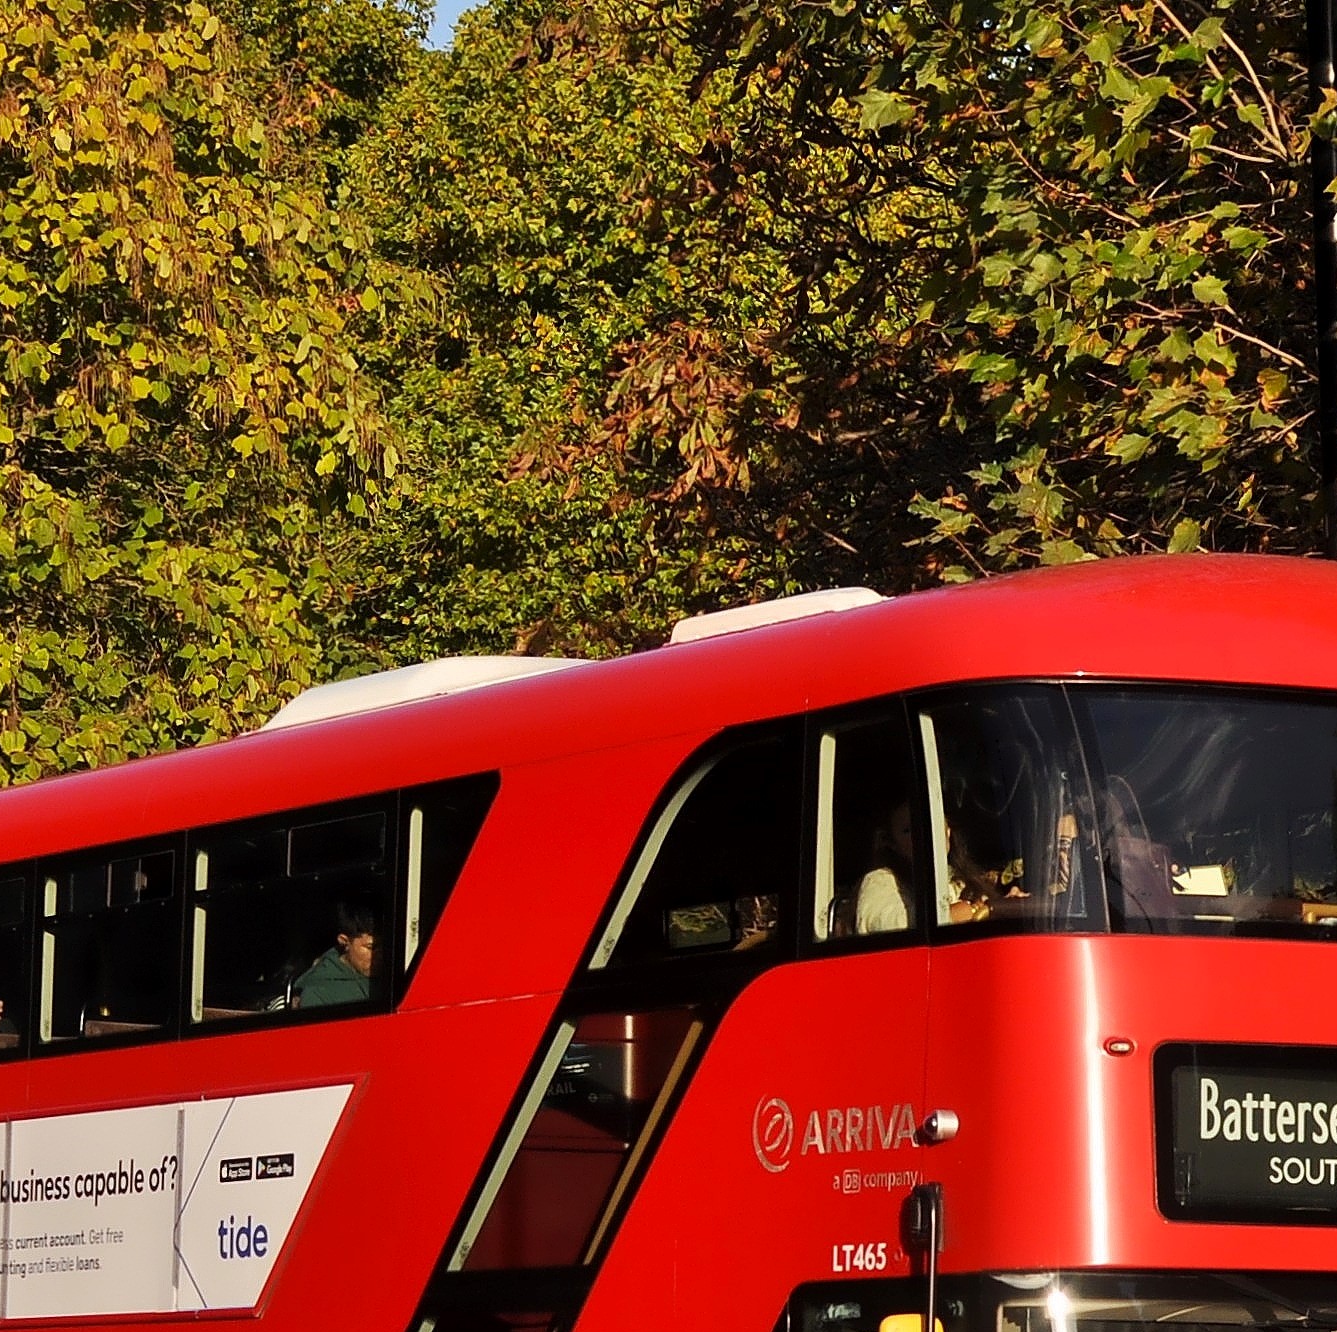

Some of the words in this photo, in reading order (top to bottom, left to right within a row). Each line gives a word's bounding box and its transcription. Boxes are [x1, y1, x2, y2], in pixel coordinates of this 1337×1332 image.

[800, 1103, 920, 1155] ARRIVA
[0, 1168, 71, 1203] business
[74, 1159, 144, 1207] capable
[149, 1155, 178, 1192] of?
[833, 1175, 840, 1189] a
[844, 1172, 860, 1191] DB
[863, 1170, 917, 1191] company
[15, 1233, 48, 1250] current
[89, 1229, 104, 1245] Get
[106, 1228, 124, 1243] free
[218, 1215, 268, 1259] tide
[28, 1257, 43, 1274] and
[45, 1256, 75, 1272] flexible
[832, 1242, 887, 1272] LT465
